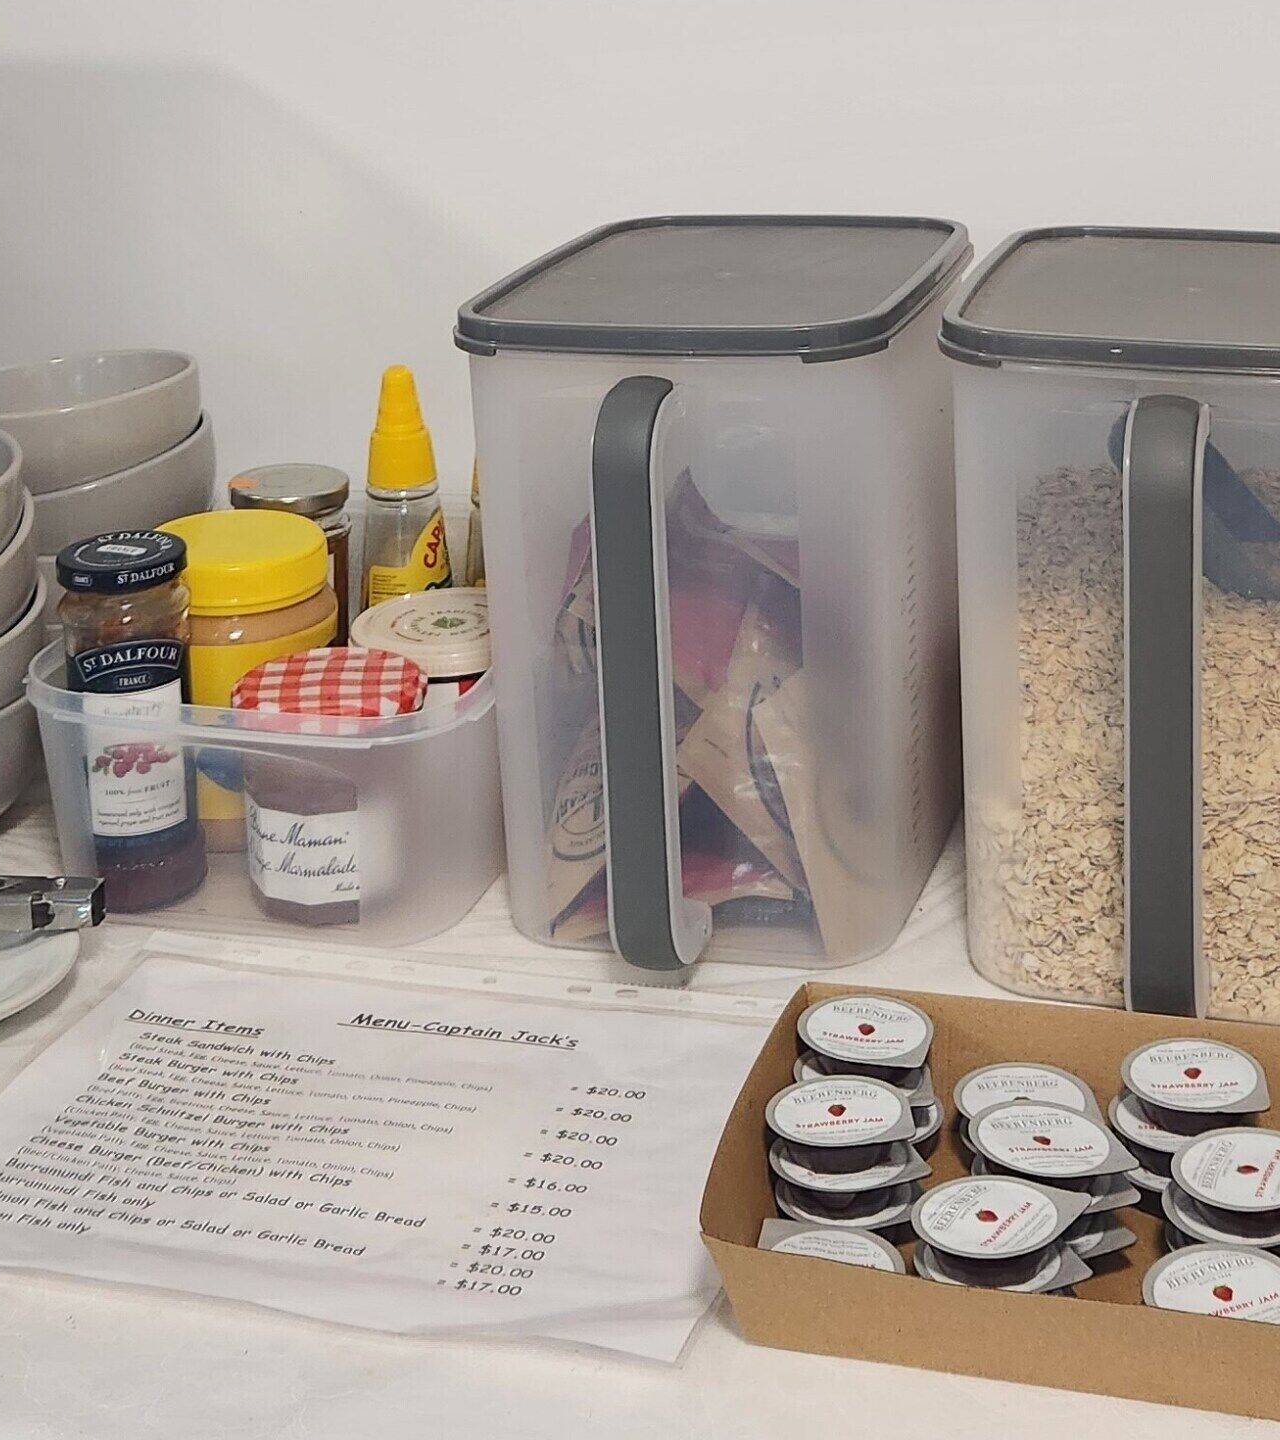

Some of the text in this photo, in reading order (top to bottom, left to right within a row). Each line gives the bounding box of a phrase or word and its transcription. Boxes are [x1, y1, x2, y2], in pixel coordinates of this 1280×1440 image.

[130, 563, 174, 583] DALFOUR
[100, 646, 177, 666] DALFOUR
[119, 675, 146, 686] FRANCE
[128, 1009, 579, 1048] Dinner Items Menu-Captain Jack's
[822, 1031, 882, 1044] STRAWBERRY
[140, 1031, 336, 1066] Steak Sandwich with Chips
[119, 1052, 299, 1085] Steak Burger with Chips
[97, 1072, 272, 1106] Beef Burger with Chips
[586, 1085, 647, 1100] $20.00
[977, 1079, 1058, 1090] BEERENBERG
[76, 1094, 351, 1136] Chicken Schnitzel Burger with Chips
[570, 1106, 632, 1123] $20.00
[795, 1118, 860, 1129] STRAWBERRY
[54, 1114, 271, 1153] Vegetable Burger with Chips
[555, 1129, 618, 1146] $20.00
[29, 1135, 353, 1188] Cheese Burger (Beef/Chicken) with Chips
[540, 1152, 603, 1170] $20.00
[4, 1157, 427, 1228] Barramundi Fish and Chips or Salad or Garlic Bread
[524, 1177, 588, 1193] $16.00
[82, 1189, 117, 1203] Fish
[122, 1196, 157, 1210] only
[507, 1202, 572, 1217] $15.00
[17, 1213, 52, 1228] Fish
[56, 1221, 92, 1234] only
[33, 1198, 69, 1212] Fish
[73, 1205, 106, 1218] and
[108, 1211, 152, 1227] Chips
[156, 1217, 176, 1227] or
[180, 1219, 230, 1236] Salad
[232, 1228, 251, 1238] or
[257, 1230, 308, 1247] Garlic
[313, 1239, 367, 1257] Bread
[489, 1226, 555, 1244] $20.00
[478, 1243, 545, 1261] $17.00
[467, 1261, 534, 1279] $20.00
[1165, 1257, 1254, 1290] BEERENBERG
[454, 1278, 522, 1296] $17.00
[1259, 1292, 1280, 1303] JAM
